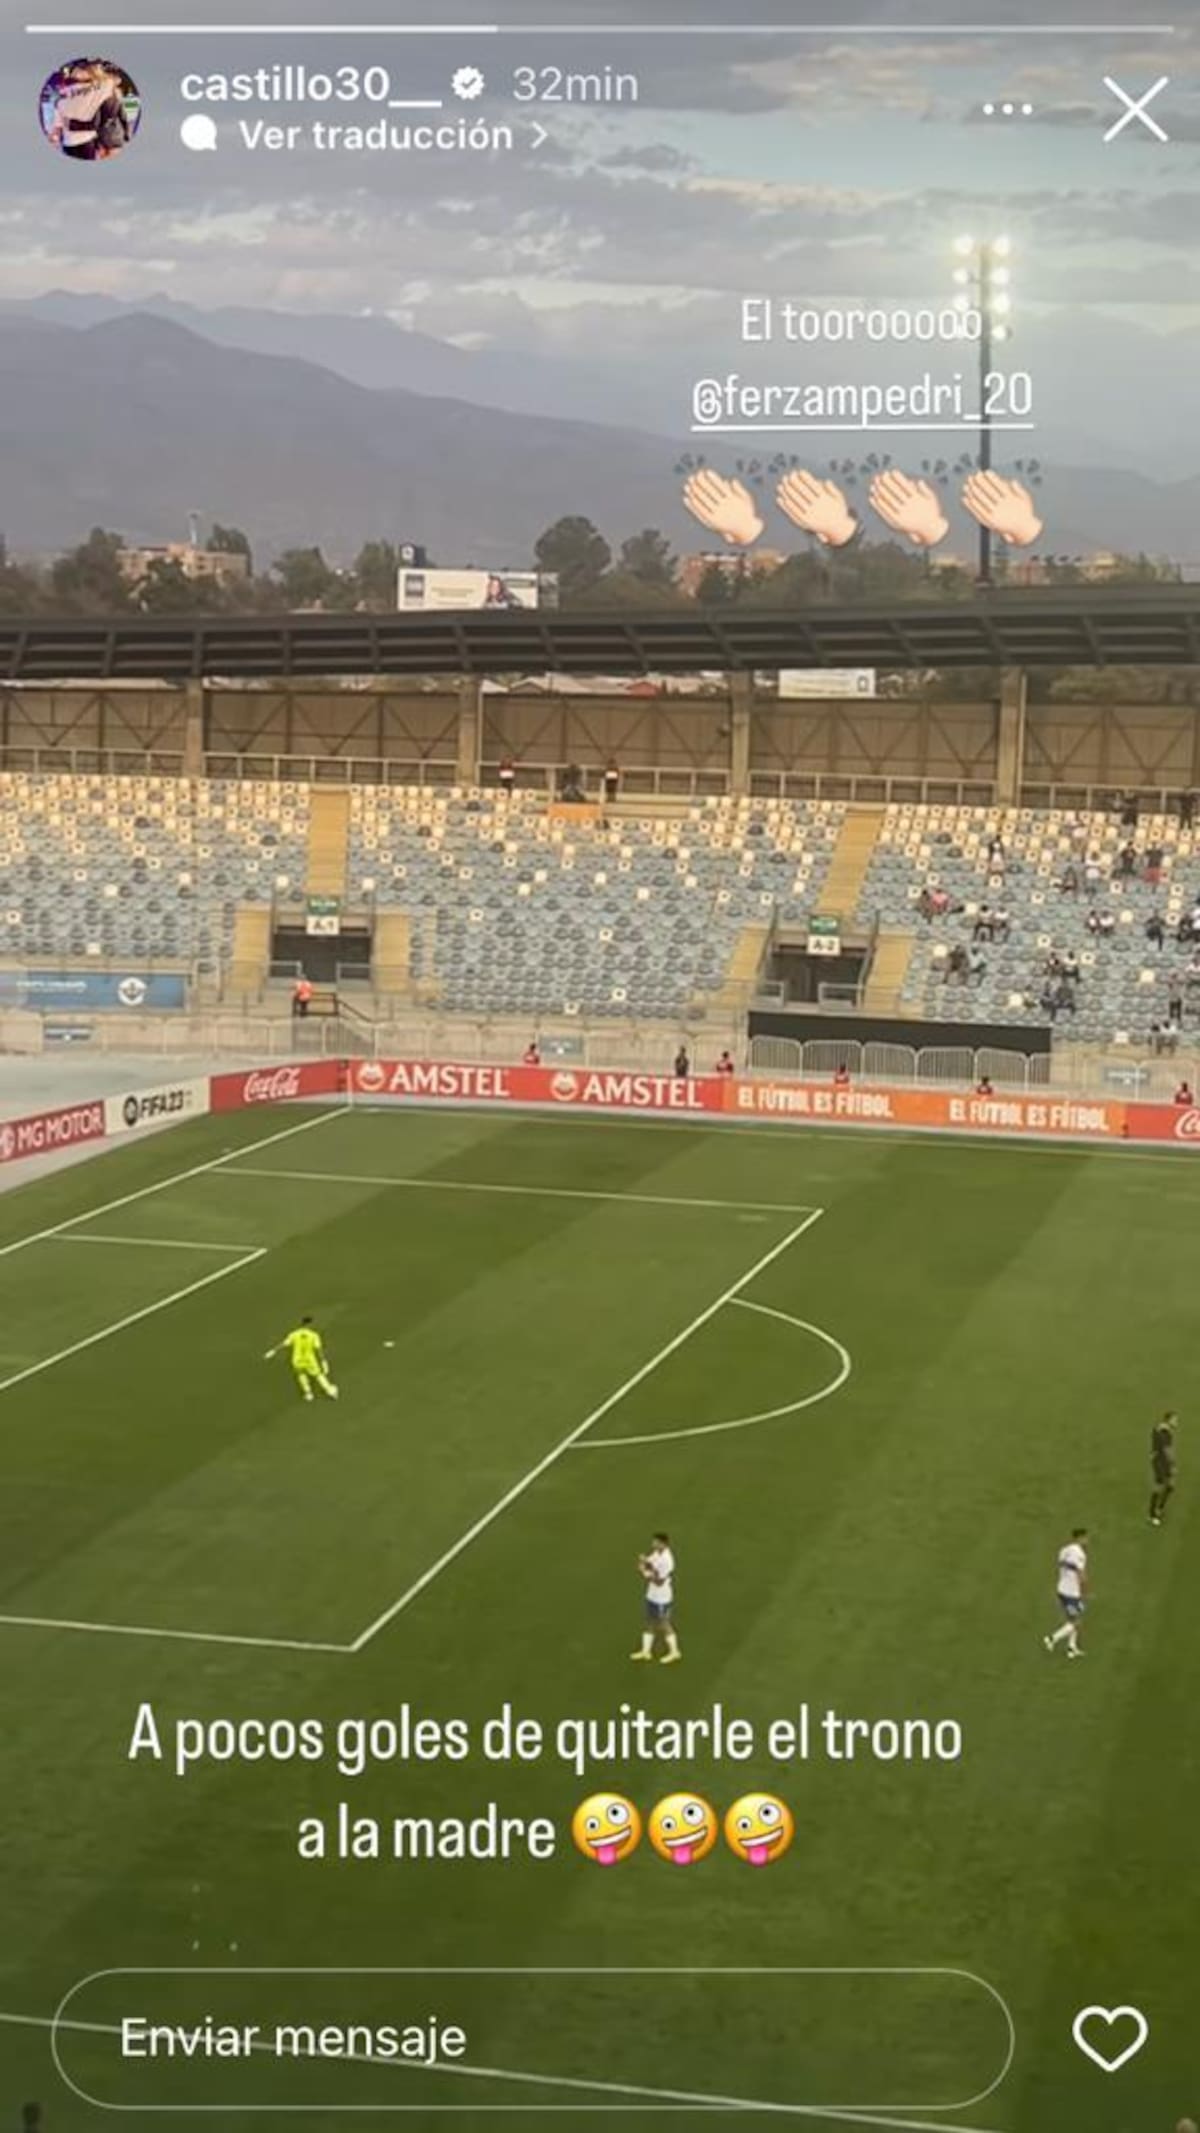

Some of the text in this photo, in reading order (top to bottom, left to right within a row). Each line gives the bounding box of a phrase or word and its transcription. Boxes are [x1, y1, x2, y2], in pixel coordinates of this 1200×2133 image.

[390, 1065, 510, 1097] AMSTEL
[583, 1075, 704, 1108] AMSTEL
[738, 1086, 755, 1109] EL
[813, 1090, 833, 1113] ES
[949, 1098, 967, 1121] EL
[1027, 1103, 1047, 1126] ES
[17, 1121, 44, 1150] MG
[46, 1106, 102, 1142] MOTOR
